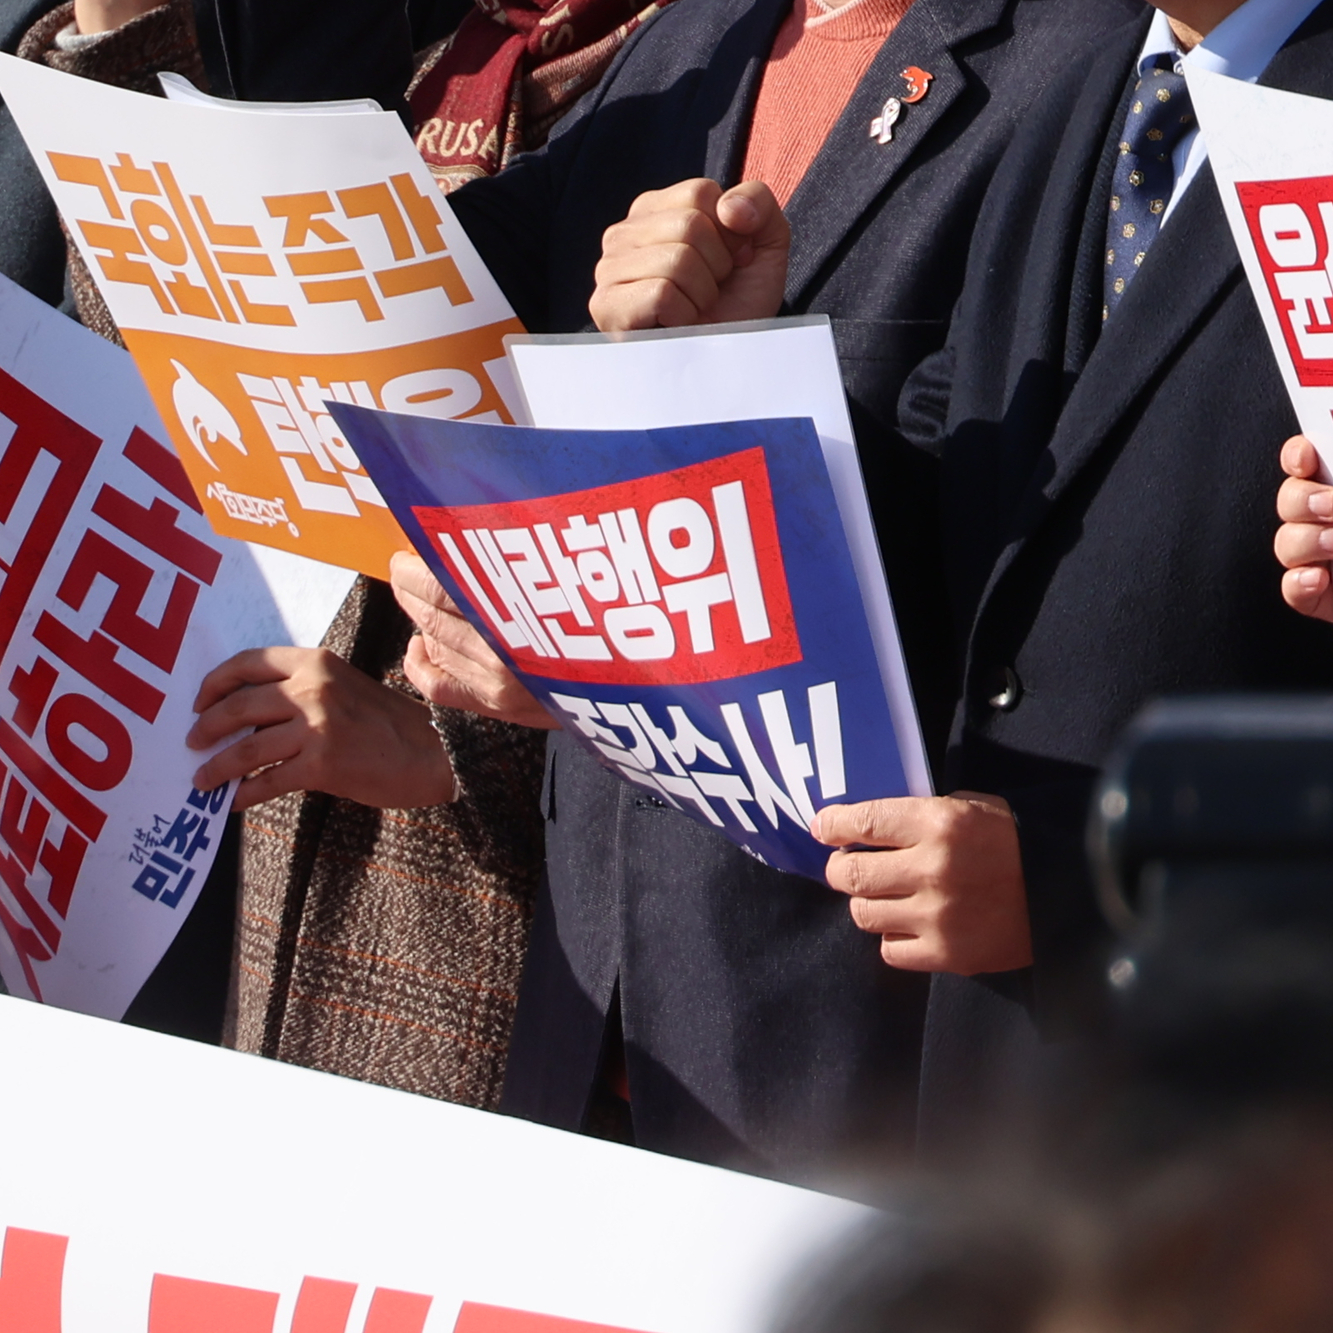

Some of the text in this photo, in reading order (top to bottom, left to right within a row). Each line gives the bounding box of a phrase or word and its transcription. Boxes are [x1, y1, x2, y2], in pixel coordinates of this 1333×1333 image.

[45, 150, 475, 327] 국회는 즉각
[437, 480, 771, 661] 내란행위
